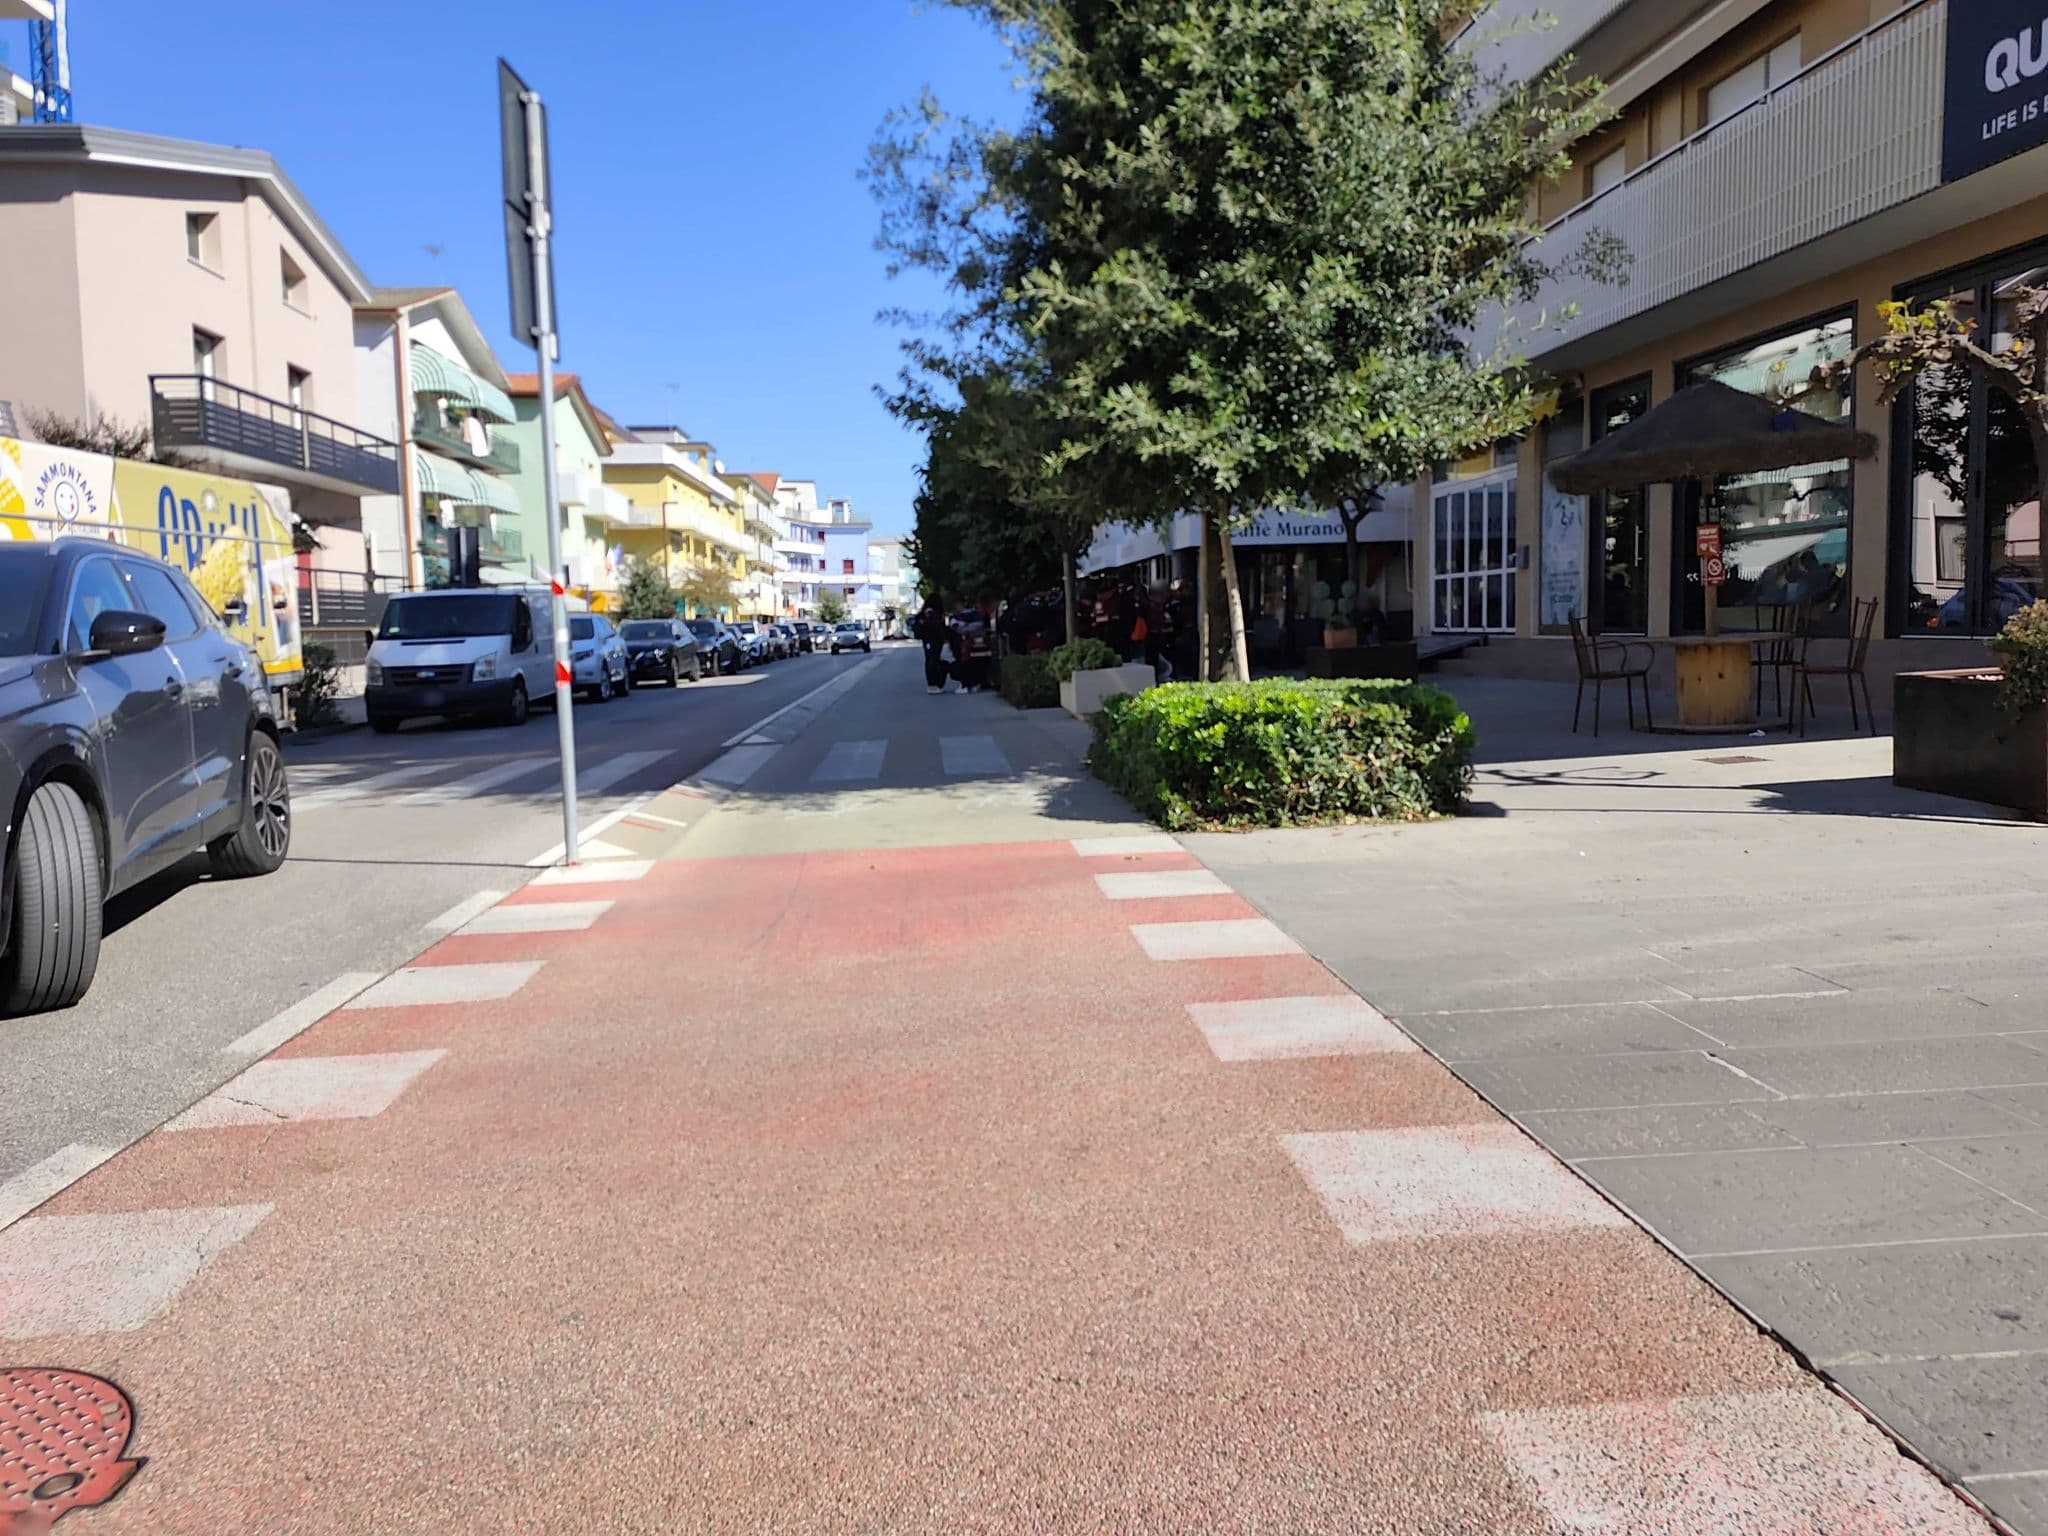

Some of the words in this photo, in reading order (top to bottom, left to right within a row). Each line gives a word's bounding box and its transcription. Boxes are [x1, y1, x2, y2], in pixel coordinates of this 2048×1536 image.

[1982, 109, 2018, 140] LIFE
[2022, 100, 2039, 123] IS
[34, 461, 97, 514] SAMMONTANA
[1276, 521, 1345, 537] Murano
